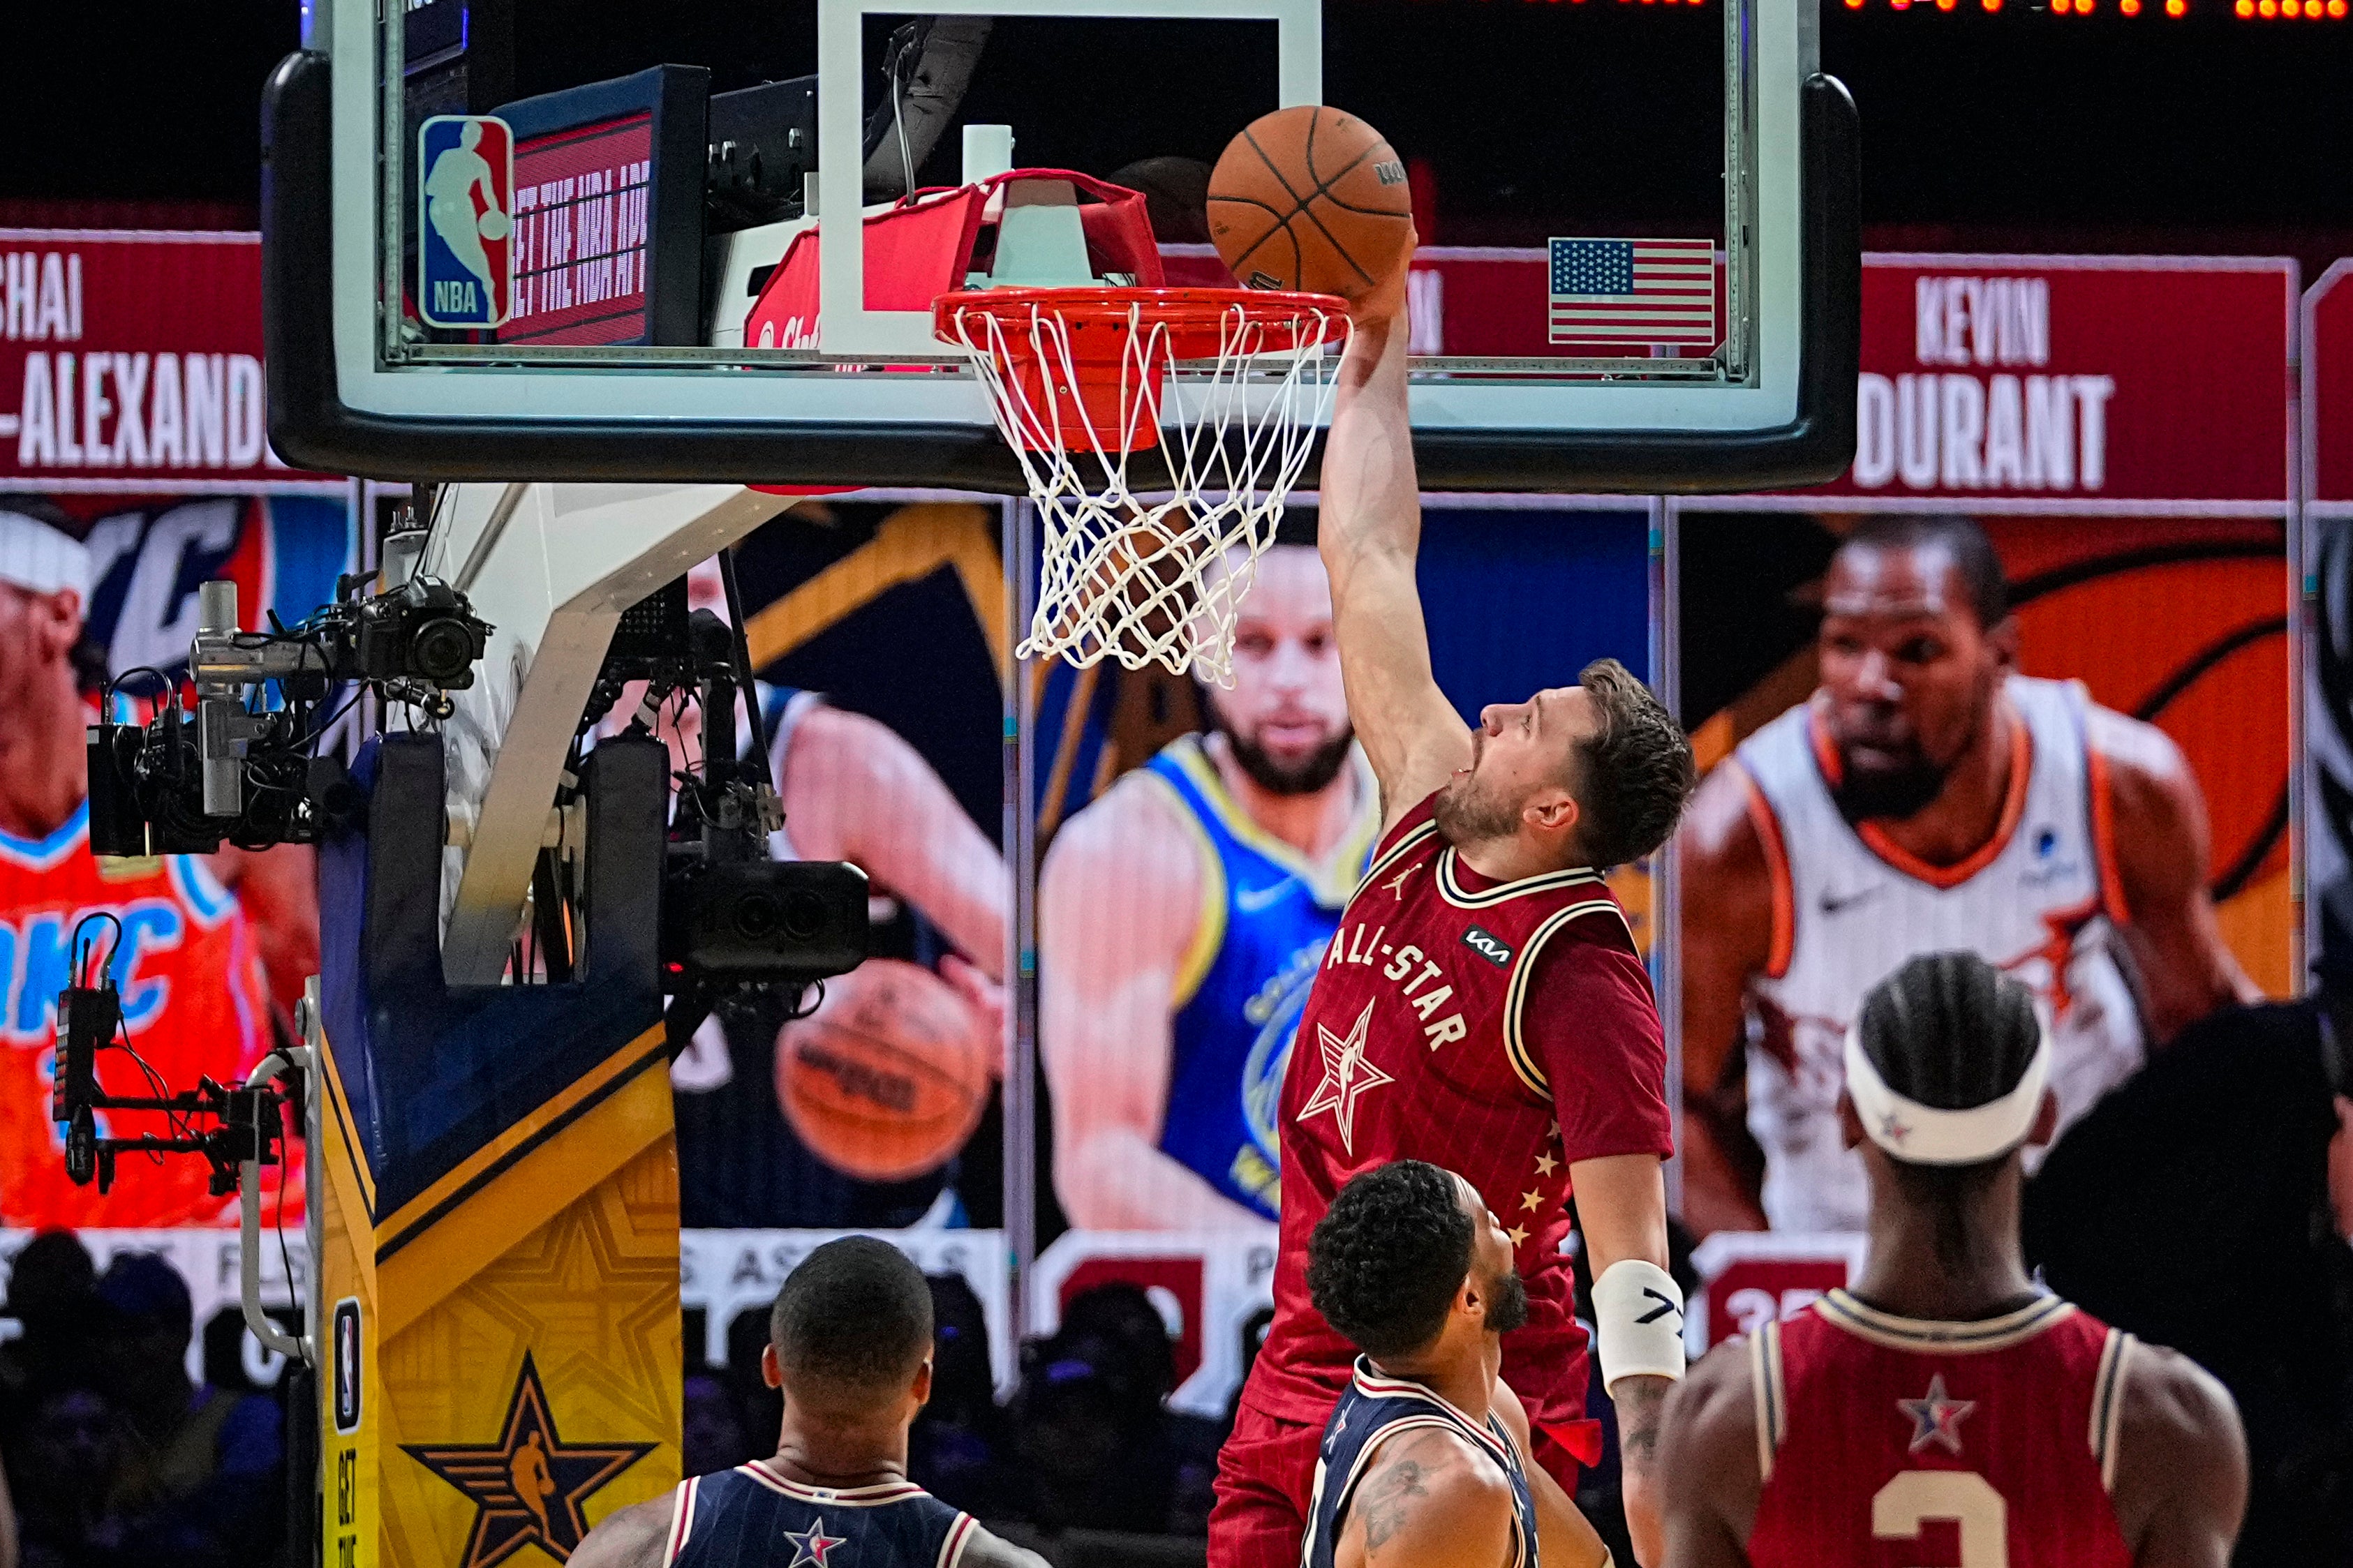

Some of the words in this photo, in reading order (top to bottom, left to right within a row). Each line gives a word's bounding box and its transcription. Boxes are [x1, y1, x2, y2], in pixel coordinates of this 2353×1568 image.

[0, 251, 83, 341] HAI
[433, 281, 477, 313] NBA
[510, 186, 538, 320] ET
[540, 177, 574, 313] THE
[575, 169, 612, 306] NBA
[1915, 276, 2051, 368] KEVIN
[1853, 372, 2116, 492] DURANT
[1327, 923, 1467, 1052] ALL-STAR
